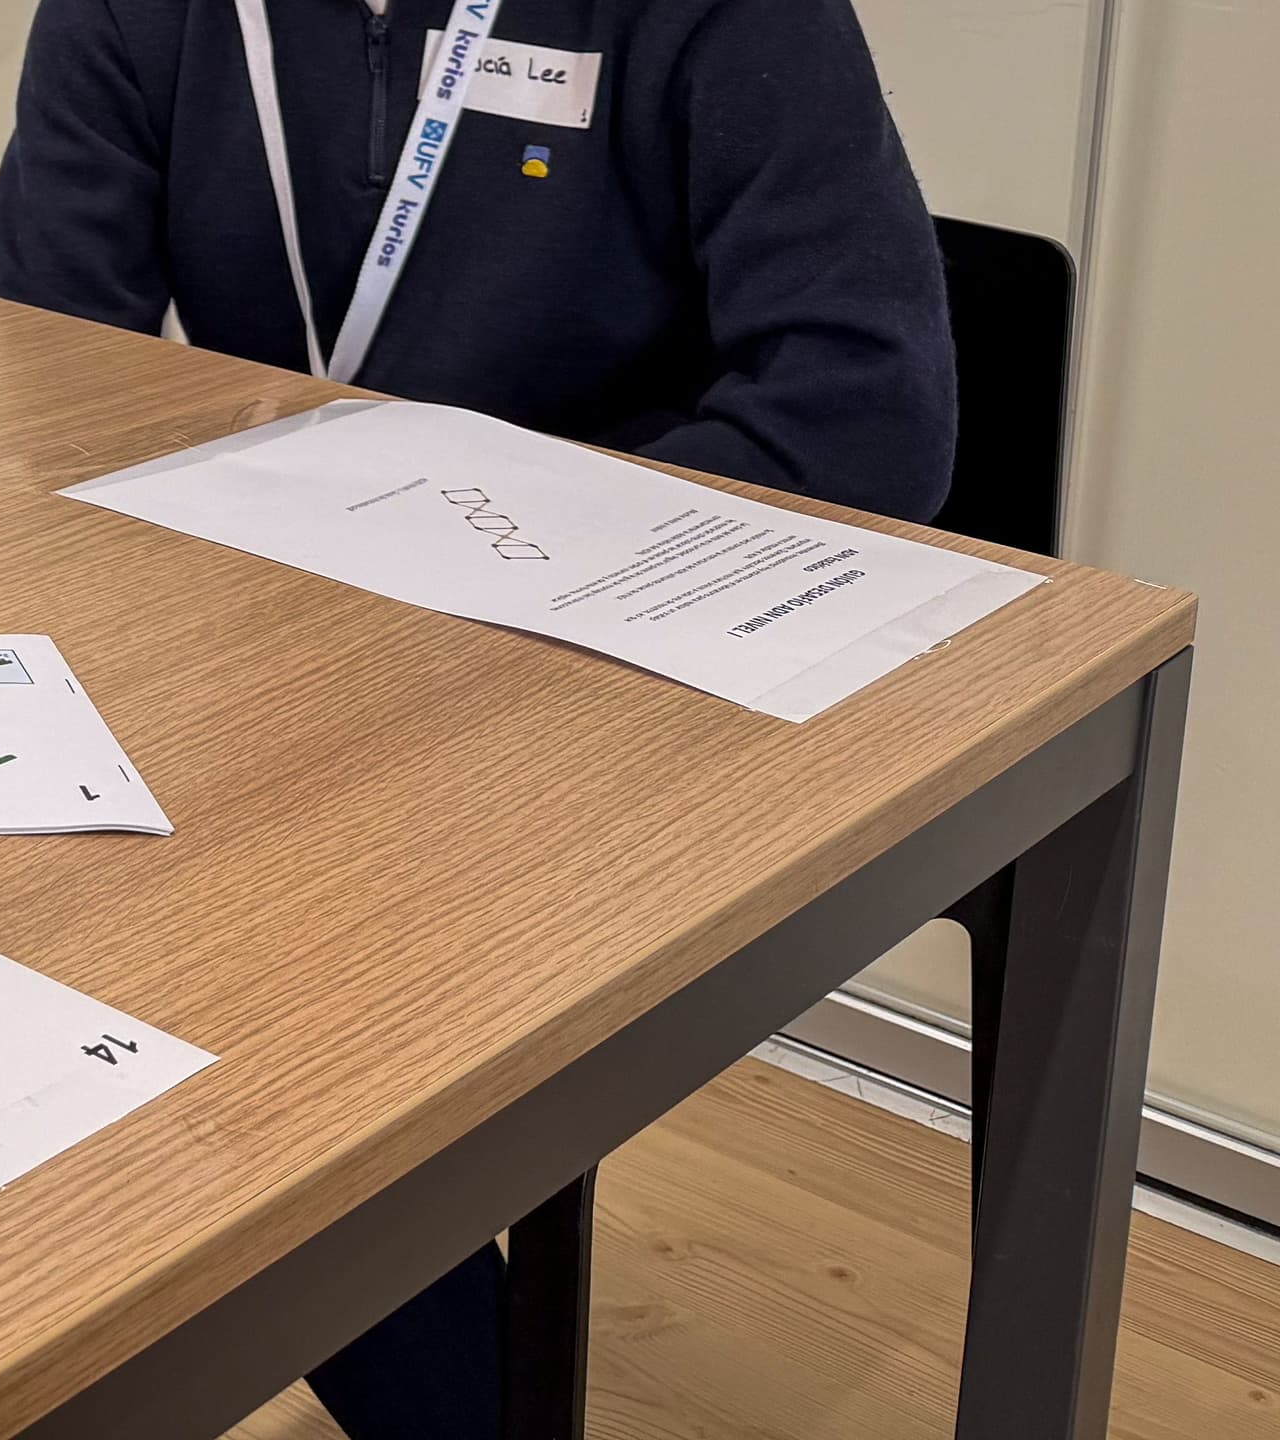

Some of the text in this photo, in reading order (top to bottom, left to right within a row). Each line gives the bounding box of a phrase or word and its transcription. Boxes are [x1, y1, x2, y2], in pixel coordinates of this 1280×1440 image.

[436, 28, 480, 101] kurios
[527, 57, 567, 84] Lee
[407, 140, 439, 191] UFV
[376, 198, 419, 268] kurios
[825, 569, 866, 588] GUIÓN
[786, 584, 836, 607] DESAFÍO
[763, 603, 795, 620] ADN
[731, 615, 773, 639] NIVEL
[78, 784, 101, 802] 1
[80, 1033, 139, 1066] 14
